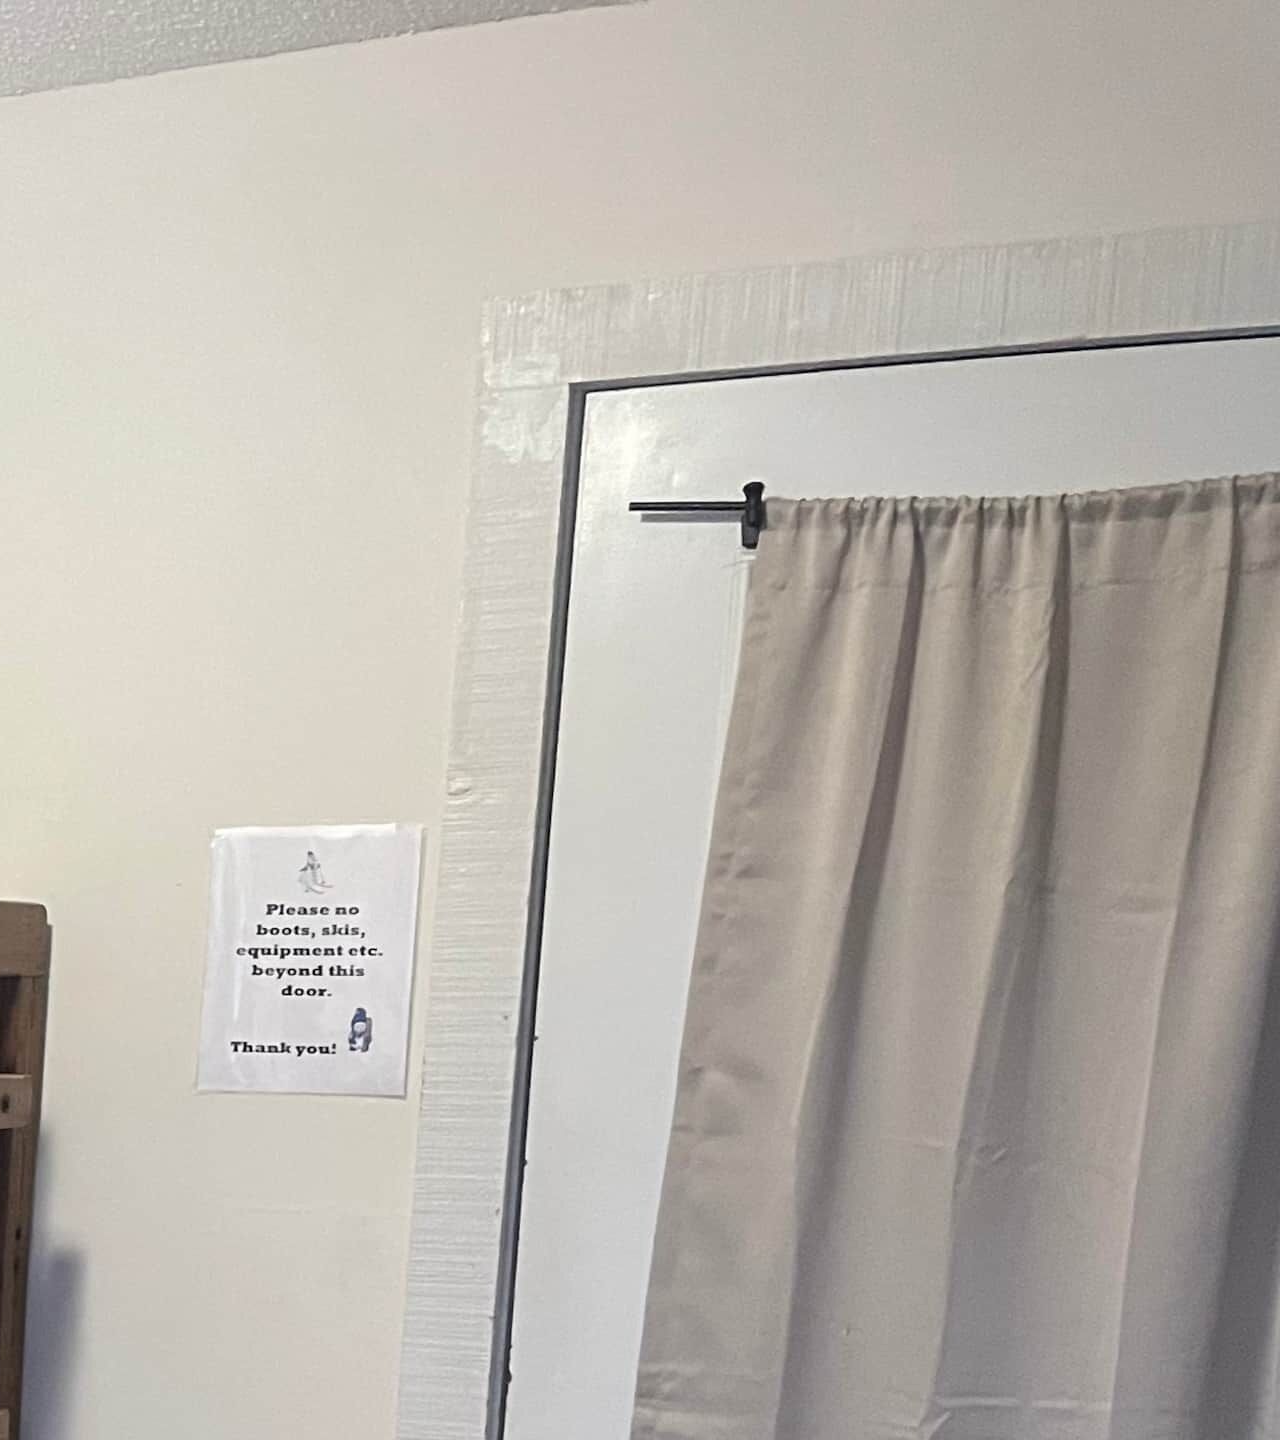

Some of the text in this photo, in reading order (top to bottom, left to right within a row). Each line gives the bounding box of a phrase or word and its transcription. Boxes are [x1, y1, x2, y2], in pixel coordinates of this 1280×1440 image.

[266, 904, 360, 915] Please no
[256, 924, 366, 939] boots, skis,
[236, 944, 383, 959] equipment etc.
[251, 965, 365, 979] beyond this
[281, 985, 332, 997] door.
[231, 1041, 336, 1056] Thank you!
